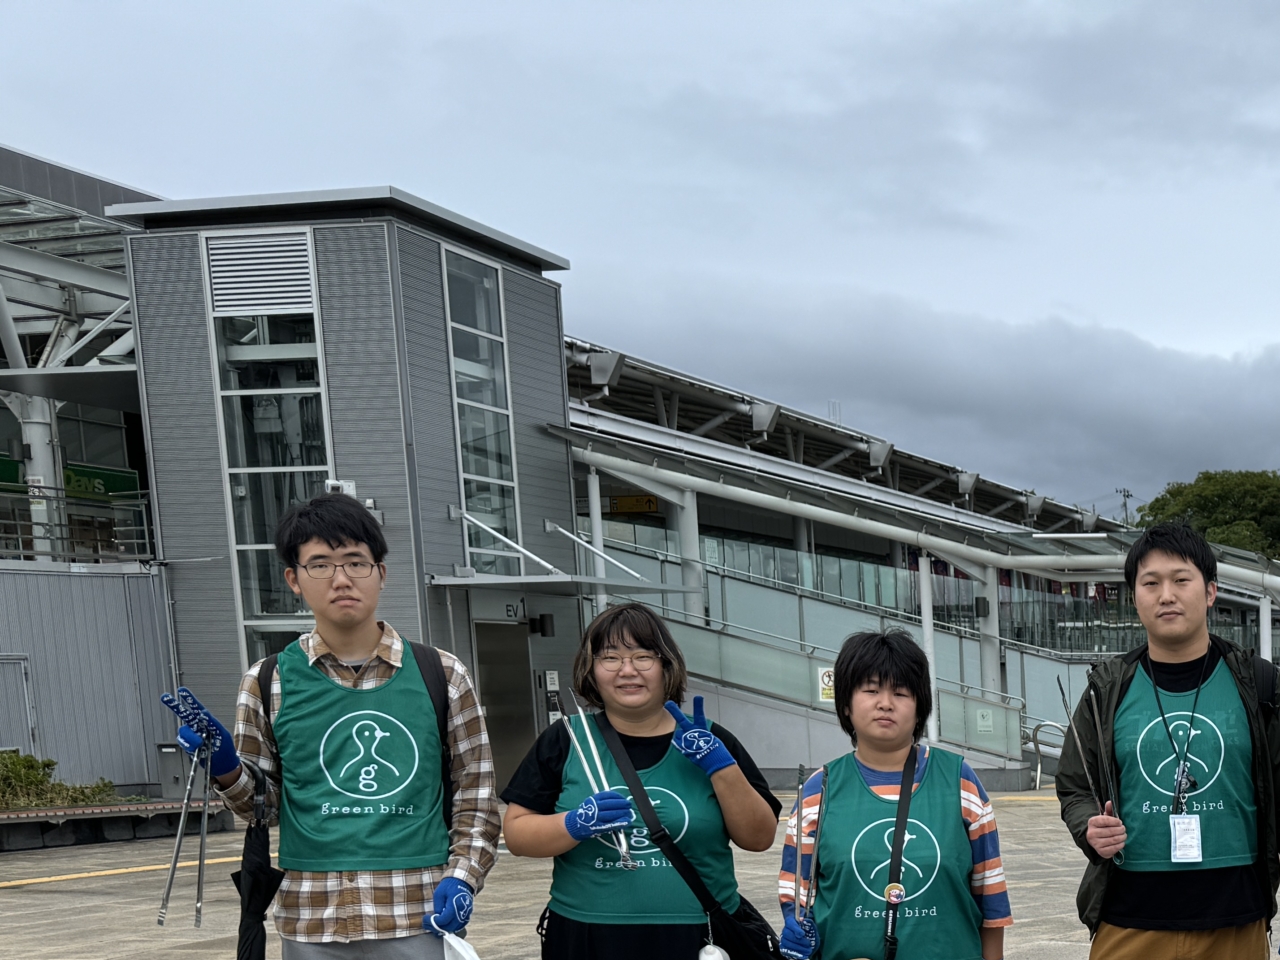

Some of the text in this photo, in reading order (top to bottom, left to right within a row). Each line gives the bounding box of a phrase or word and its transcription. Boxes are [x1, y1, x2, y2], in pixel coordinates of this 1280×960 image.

[506, 597, 527, 619] EV 1
[321, 803, 414, 815] green bird
[1193, 800, 1224, 812] bird
[594, 857, 647, 869] gren
[905, 906, 937, 917] bird
